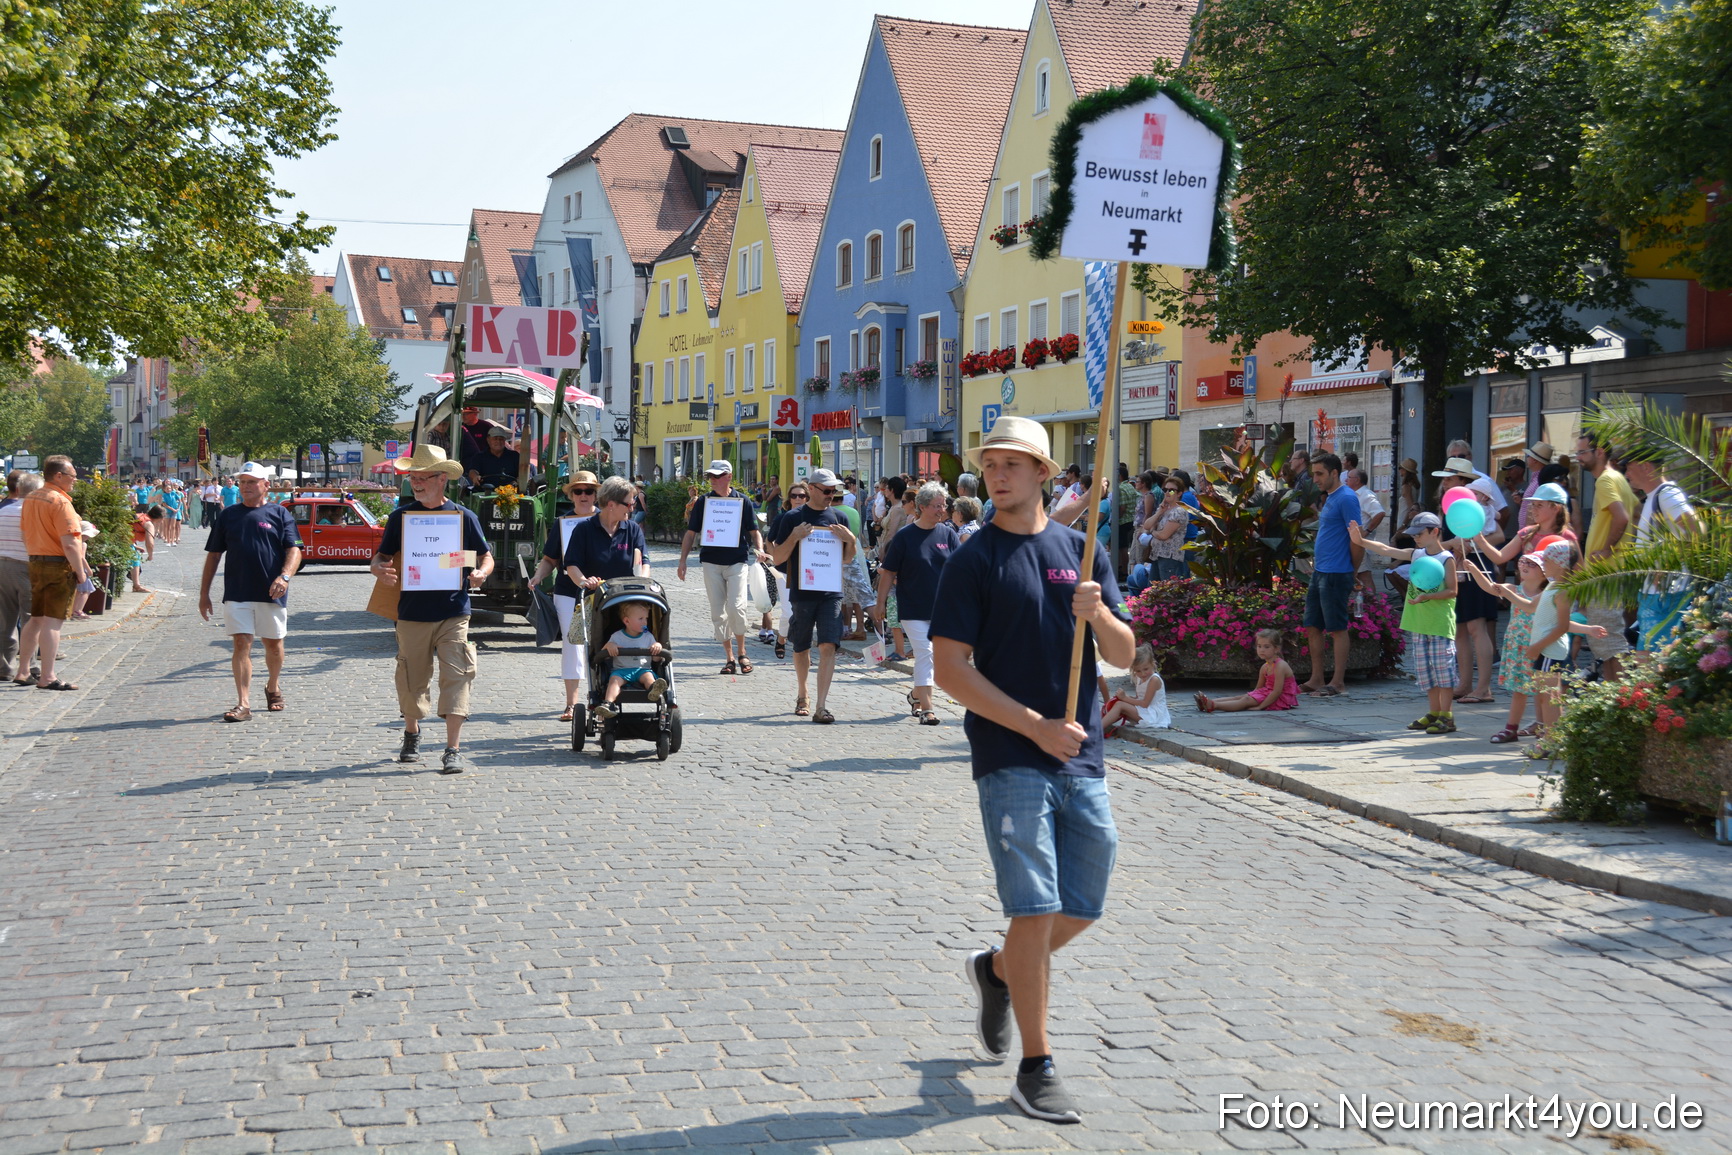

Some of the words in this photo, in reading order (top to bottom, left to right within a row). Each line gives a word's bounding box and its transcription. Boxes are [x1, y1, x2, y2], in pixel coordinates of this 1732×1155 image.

[1085, 161, 1158, 184] Bewusst
[1163, 169, 1207, 188] leben
[1141, 189, 1149, 198] in
[1102, 200, 1183, 223] Neumarkt
[471, 305, 577, 366] KAB
[1132, 323, 1149, 332] KINO
[669, 335, 688, 352] HOTEL
[1230, 375, 1244, 388] DE
[1246, 361, 1254, 390] P
[1168, 364, 1176, 415] KINO
[1197, 382, 1208, 397] DER
[986, 408, 997, 429] P
[666, 421, 693, 434] Restaurant
[317, 545, 372, 558] Günching
[1046, 568, 1078, 580] KAB
